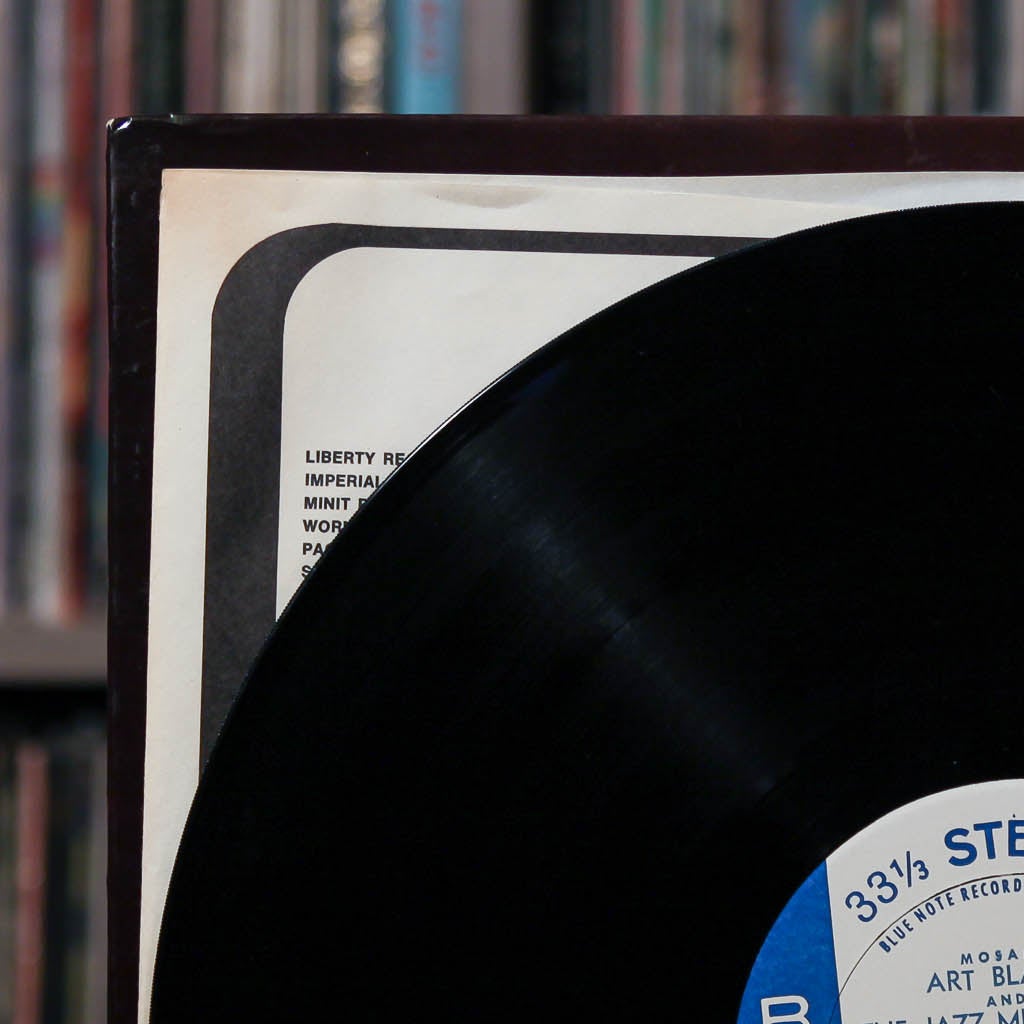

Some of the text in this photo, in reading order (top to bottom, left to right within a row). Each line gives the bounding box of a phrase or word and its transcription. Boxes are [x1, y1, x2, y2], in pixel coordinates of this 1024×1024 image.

[305, 450, 376, 465] LIBERTY
[304, 497, 351, 511] MINIT
[878, 918, 914, 953] BLUE
[913, 892, 956, 923] NOTE
[926, 970, 975, 993] ART
